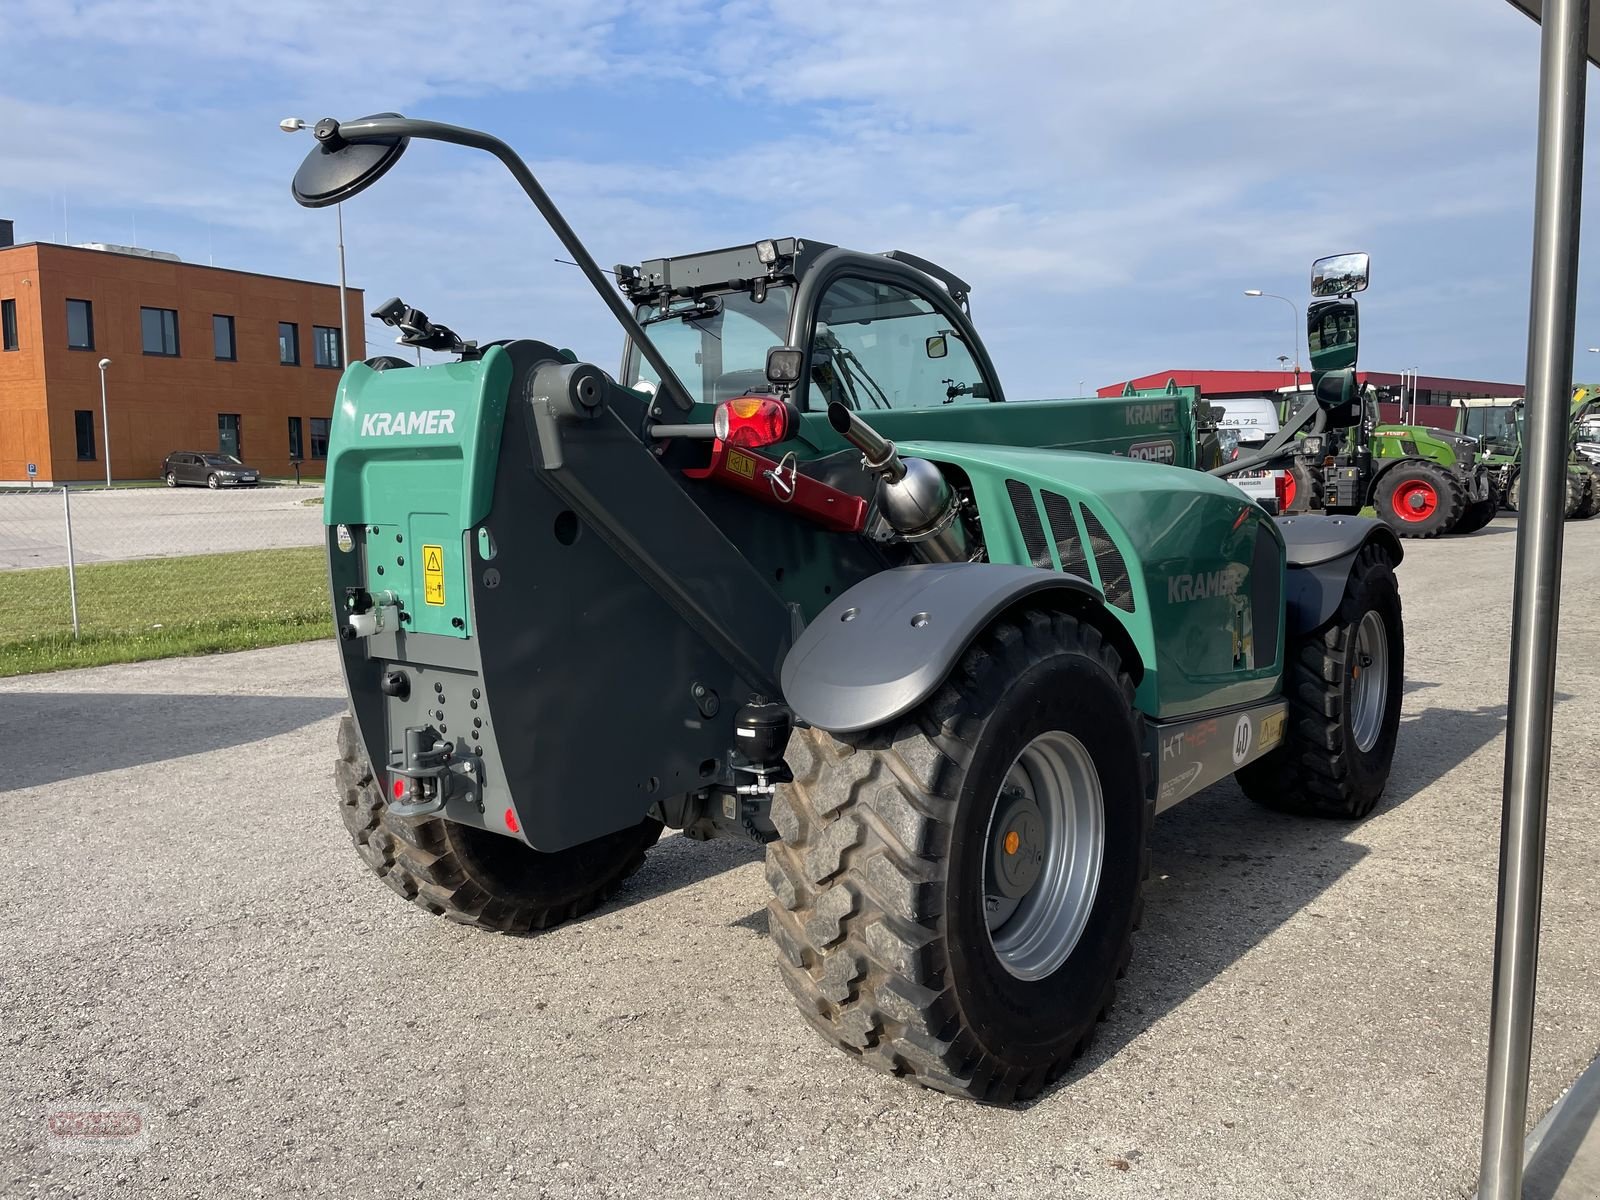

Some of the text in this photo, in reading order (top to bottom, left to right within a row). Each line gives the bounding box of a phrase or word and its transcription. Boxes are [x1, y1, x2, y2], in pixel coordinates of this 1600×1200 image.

[361, 409, 456, 437] KRAMER
[1125, 403, 1176, 425] KRAMER
[29, 464, 35, 472] P
[1235, 723, 1248, 757] 40
